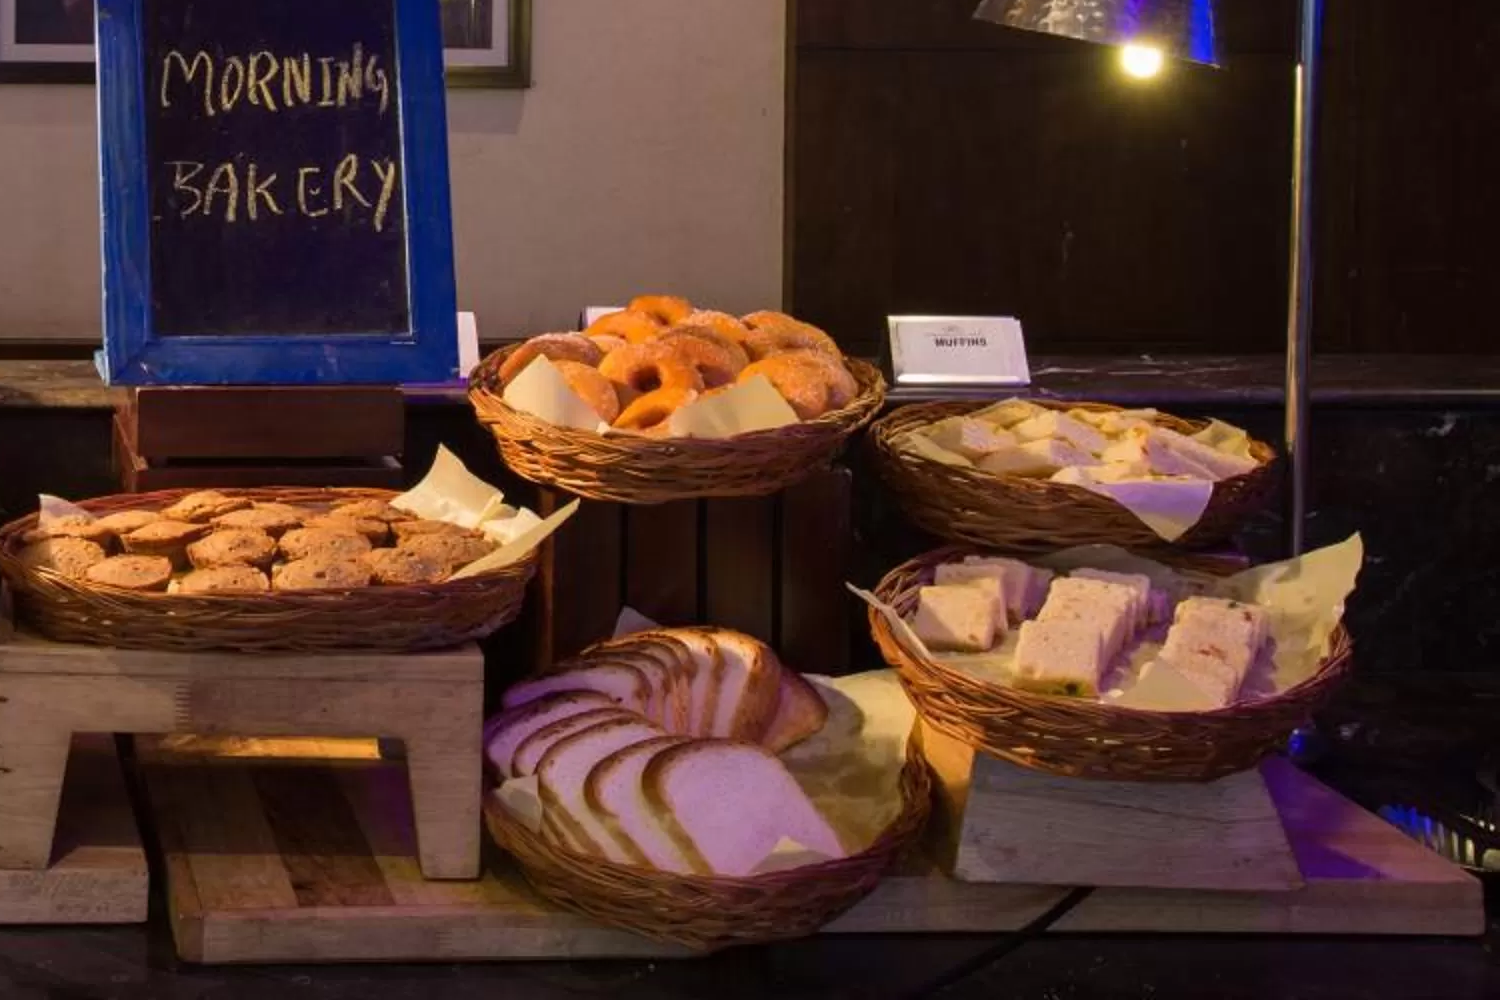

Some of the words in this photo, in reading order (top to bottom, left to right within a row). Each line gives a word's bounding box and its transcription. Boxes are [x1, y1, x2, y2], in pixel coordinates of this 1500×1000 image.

[161, 43, 388, 116] MORNING
[163, 153, 396, 232] BAKERY
[935, 337, 987, 347] MUFFINS
